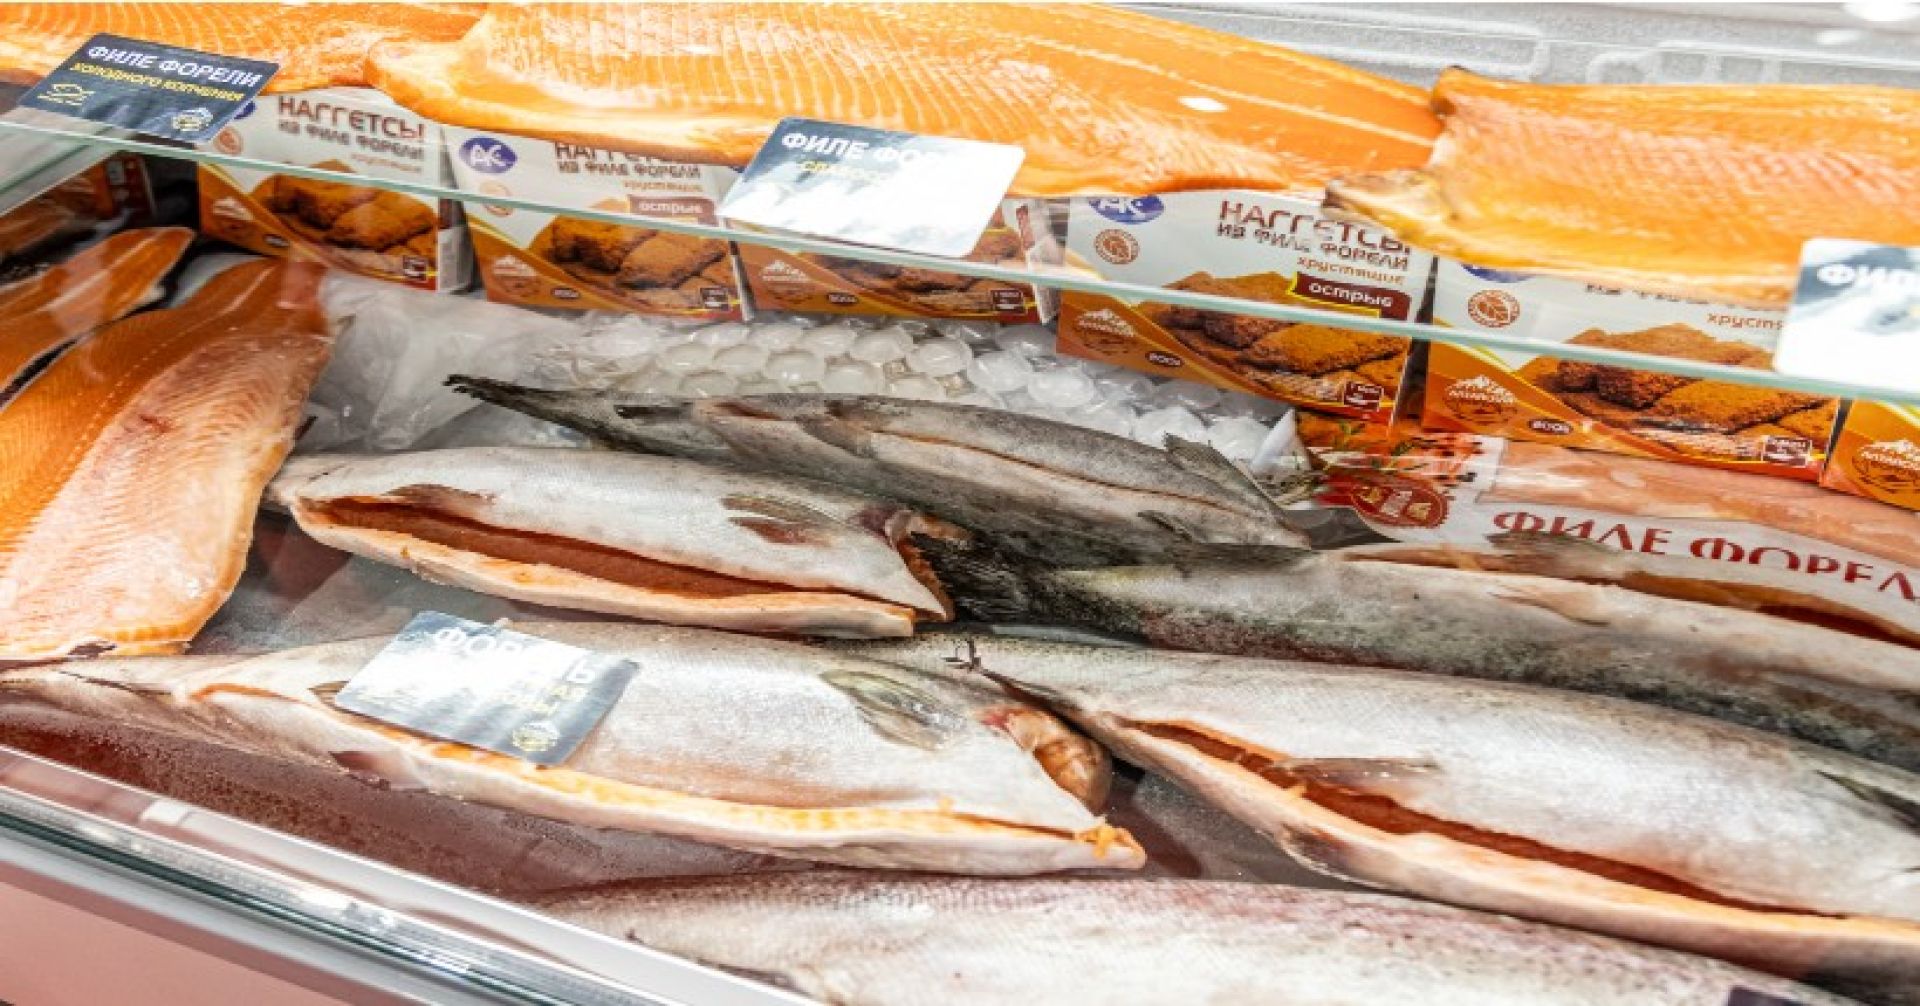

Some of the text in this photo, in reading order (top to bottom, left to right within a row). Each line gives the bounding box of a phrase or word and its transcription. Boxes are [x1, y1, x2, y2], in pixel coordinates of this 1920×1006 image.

[88, 46, 262, 87] ФИЛЕ ФОРЕЛИ
[278, 96, 425, 140] НАГГЕТСЫ
[781, 132, 869, 160] ФИЛЕ
[1320, 242, 1409, 270] ФОРЕЛИ
[1308, 281, 1394, 308] острые
[1493, 511, 1673, 555] ФИЛЕ
